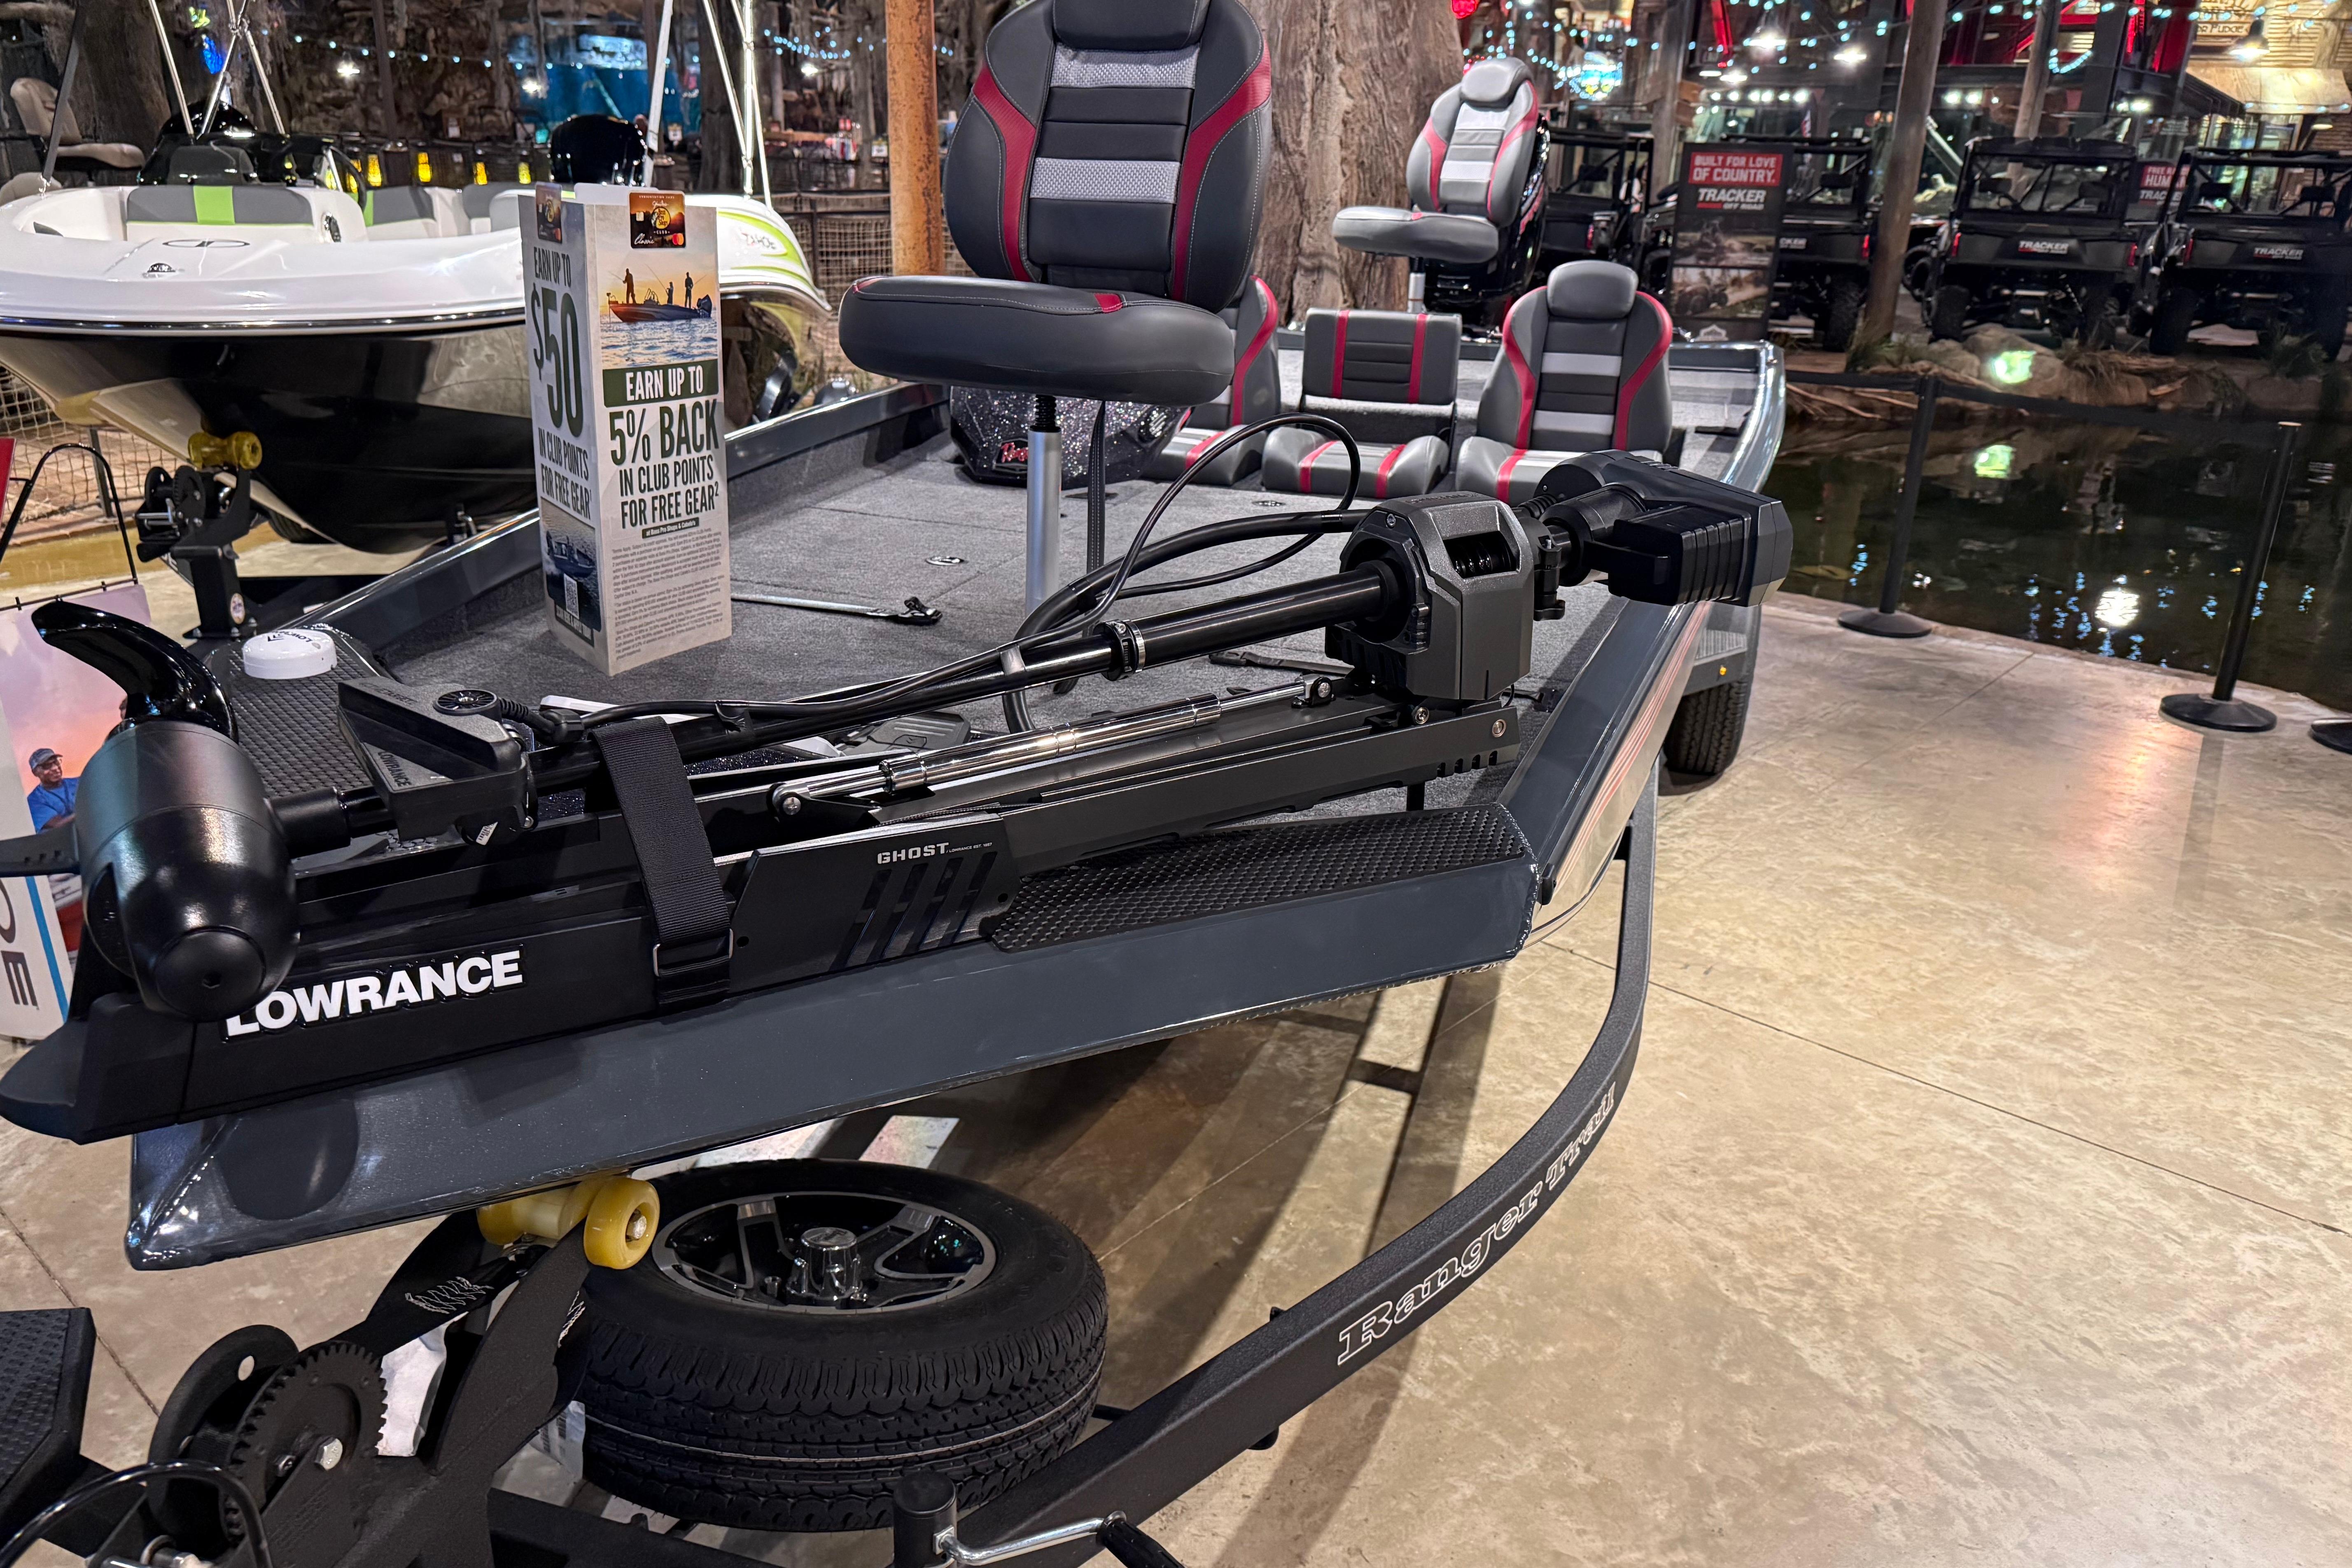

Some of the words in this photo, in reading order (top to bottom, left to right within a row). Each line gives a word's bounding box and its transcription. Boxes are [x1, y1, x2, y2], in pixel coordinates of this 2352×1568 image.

[1693, 168, 1710, 180] OF
[1713, 168, 1775, 183] COUNTRY.
[1695, 155, 1723, 166] BUILT
[1727, 156, 1746, 166] FOR
[1750, 157, 1776, 168] LOVE
[1698, 188, 1766, 202] TRACKER
[634, 233, 655, 245] Classic
[2019, 241, 2069, 250] TRACKER
[2254, 247, 2303, 257] TRACKER
[534, 247, 552, 282] EARN
[552, 251, 561, 285] UP
[561, 253, 572, 288] TO
[531, 282, 583, 437] $50
[626, 369, 663, 401] EARN
[668, 367, 685, 397] UP
[688, 365, 704, 393] TO
[609, 408, 651, 466] 5%
[660, 399, 719, 459] BACK
[538, 427, 546, 459] IN
[547, 431, 562, 467] CLUB
[563, 440, 589, 481] POINTS
[541, 463, 554, 499] FOR
[554, 470, 571, 509] FREE
[619, 468, 634, 497] IN
[638, 463, 670, 494] CLUB
[674, 455, 714, 487] POINTS
[621, 498, 647, 529] FOR
[652, 491, 681, 523] FREE
[667, 524, 678, 532] Shops
[378, 752, 412, 787] LOWRANCE
[877, 842, 949, 864] GHOST
[226, 950, 523, 1036] LOWRANCE
[1337, 1181, 1543, 1365] Ranger
[1546, 1081, 1616, 1190] Trail
